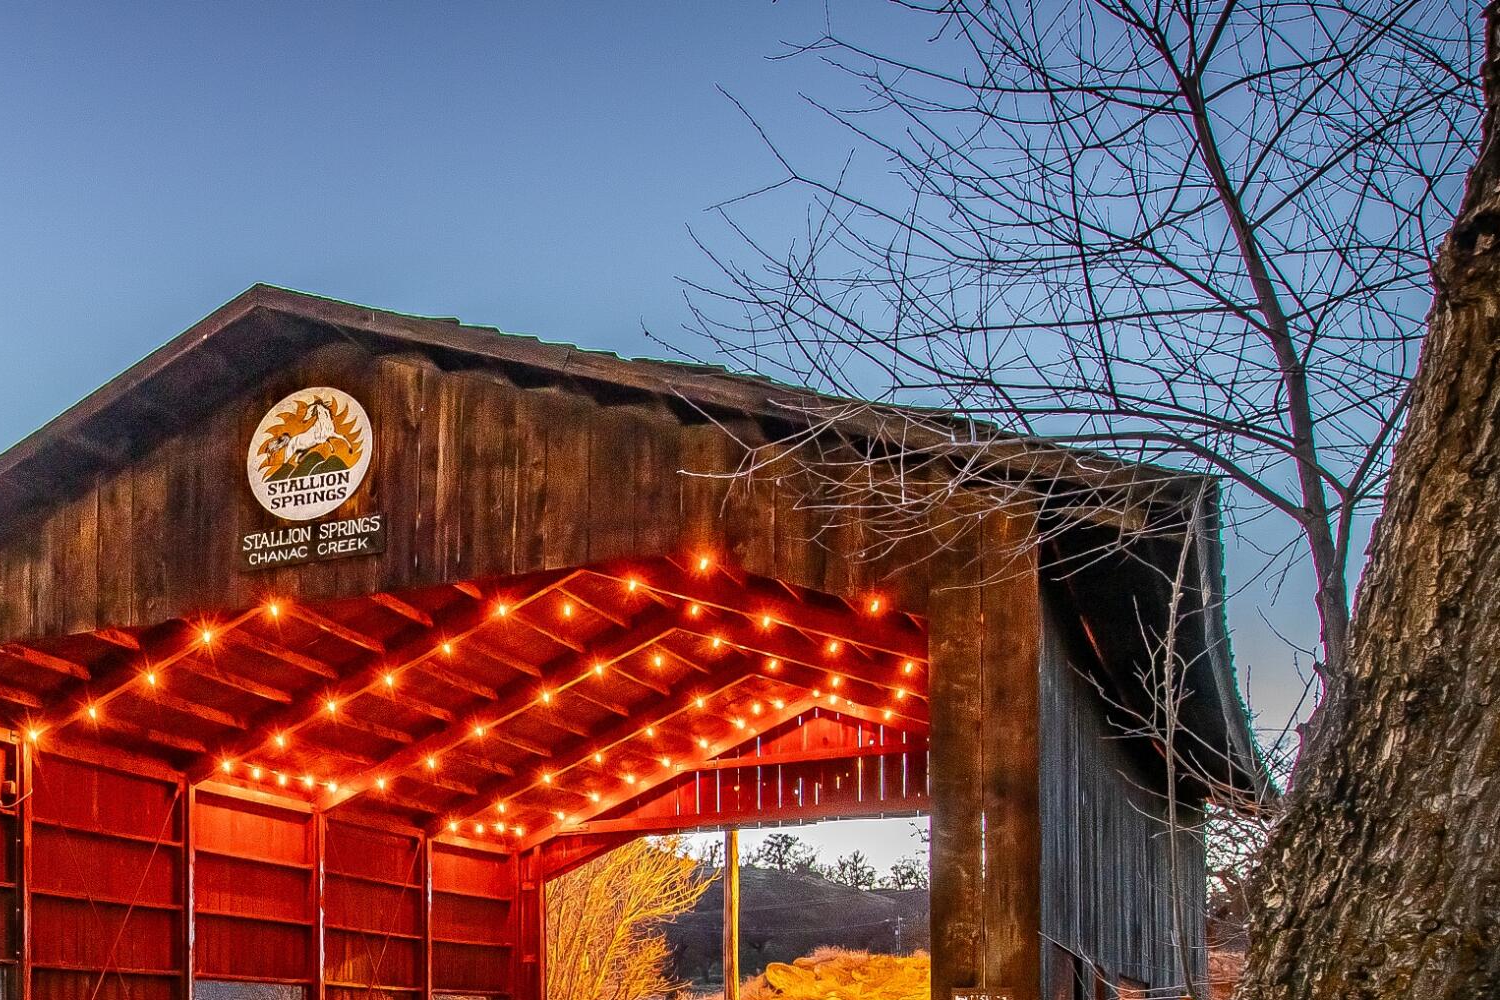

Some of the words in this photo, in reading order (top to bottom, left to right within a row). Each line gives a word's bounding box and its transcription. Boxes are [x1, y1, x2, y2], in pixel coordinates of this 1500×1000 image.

[267, 470, 350, 497] STALLION
[270, 486, 348, 510] SPRINGS
[242, 526, 312, 552] STALLION
[319, 515, 381, 540] SPRINGS
[248, 546, 308, 566] CHANAC
[317, 537, 369, 555] CREEK
